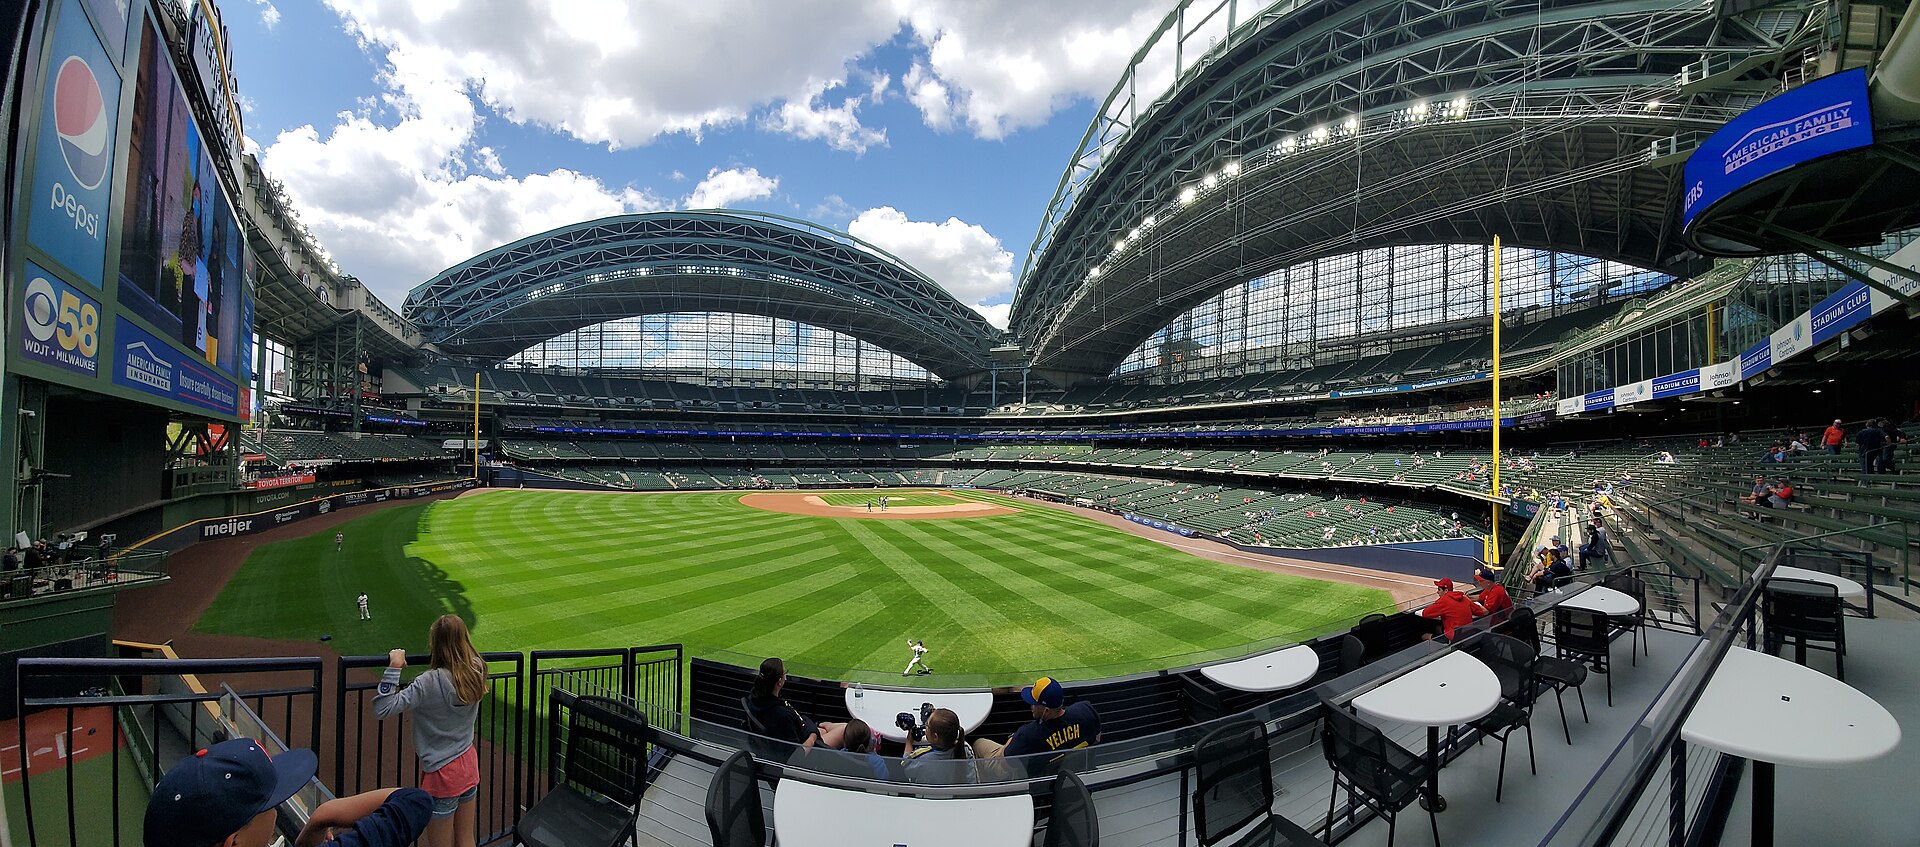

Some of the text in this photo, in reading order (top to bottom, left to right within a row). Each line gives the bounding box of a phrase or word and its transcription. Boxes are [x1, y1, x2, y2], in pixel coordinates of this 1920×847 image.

[1725, 107, 1851, 165] AMERICAN FAMILY
[1732, 123, 1840, 169] INSURANCE
[51, 182, 98, 239] pepsi
[1813, 292, 1867, 330] STADIUM CLUB
[56, 289, 99, 358] 58
[25, 338, 96, 371] WDJT MILWAUKEE
[1776, 337, 1792, 351] Johnson
[1779, 345, 1796, 358] Controls
[127, 353, 172, 380] AMERICAN FAMILY
[1741, 348, 1770, 370] STADIUM CLUB
[130, 368, 169, 389] INSURANCE
[179, 370, 195, 391] Insure
[1653, 377, 1698, 392] STADIUM CLUB
[1585, 397, 1602, 405] STADIUM
[257, 475, 304, 488] TOYOTA TERRITORY
[256, 492, 290, 504] TOYOTA.COM
[204, 518, 252, 536] meijer
[1046, 723, 1080, 751] YELICH
